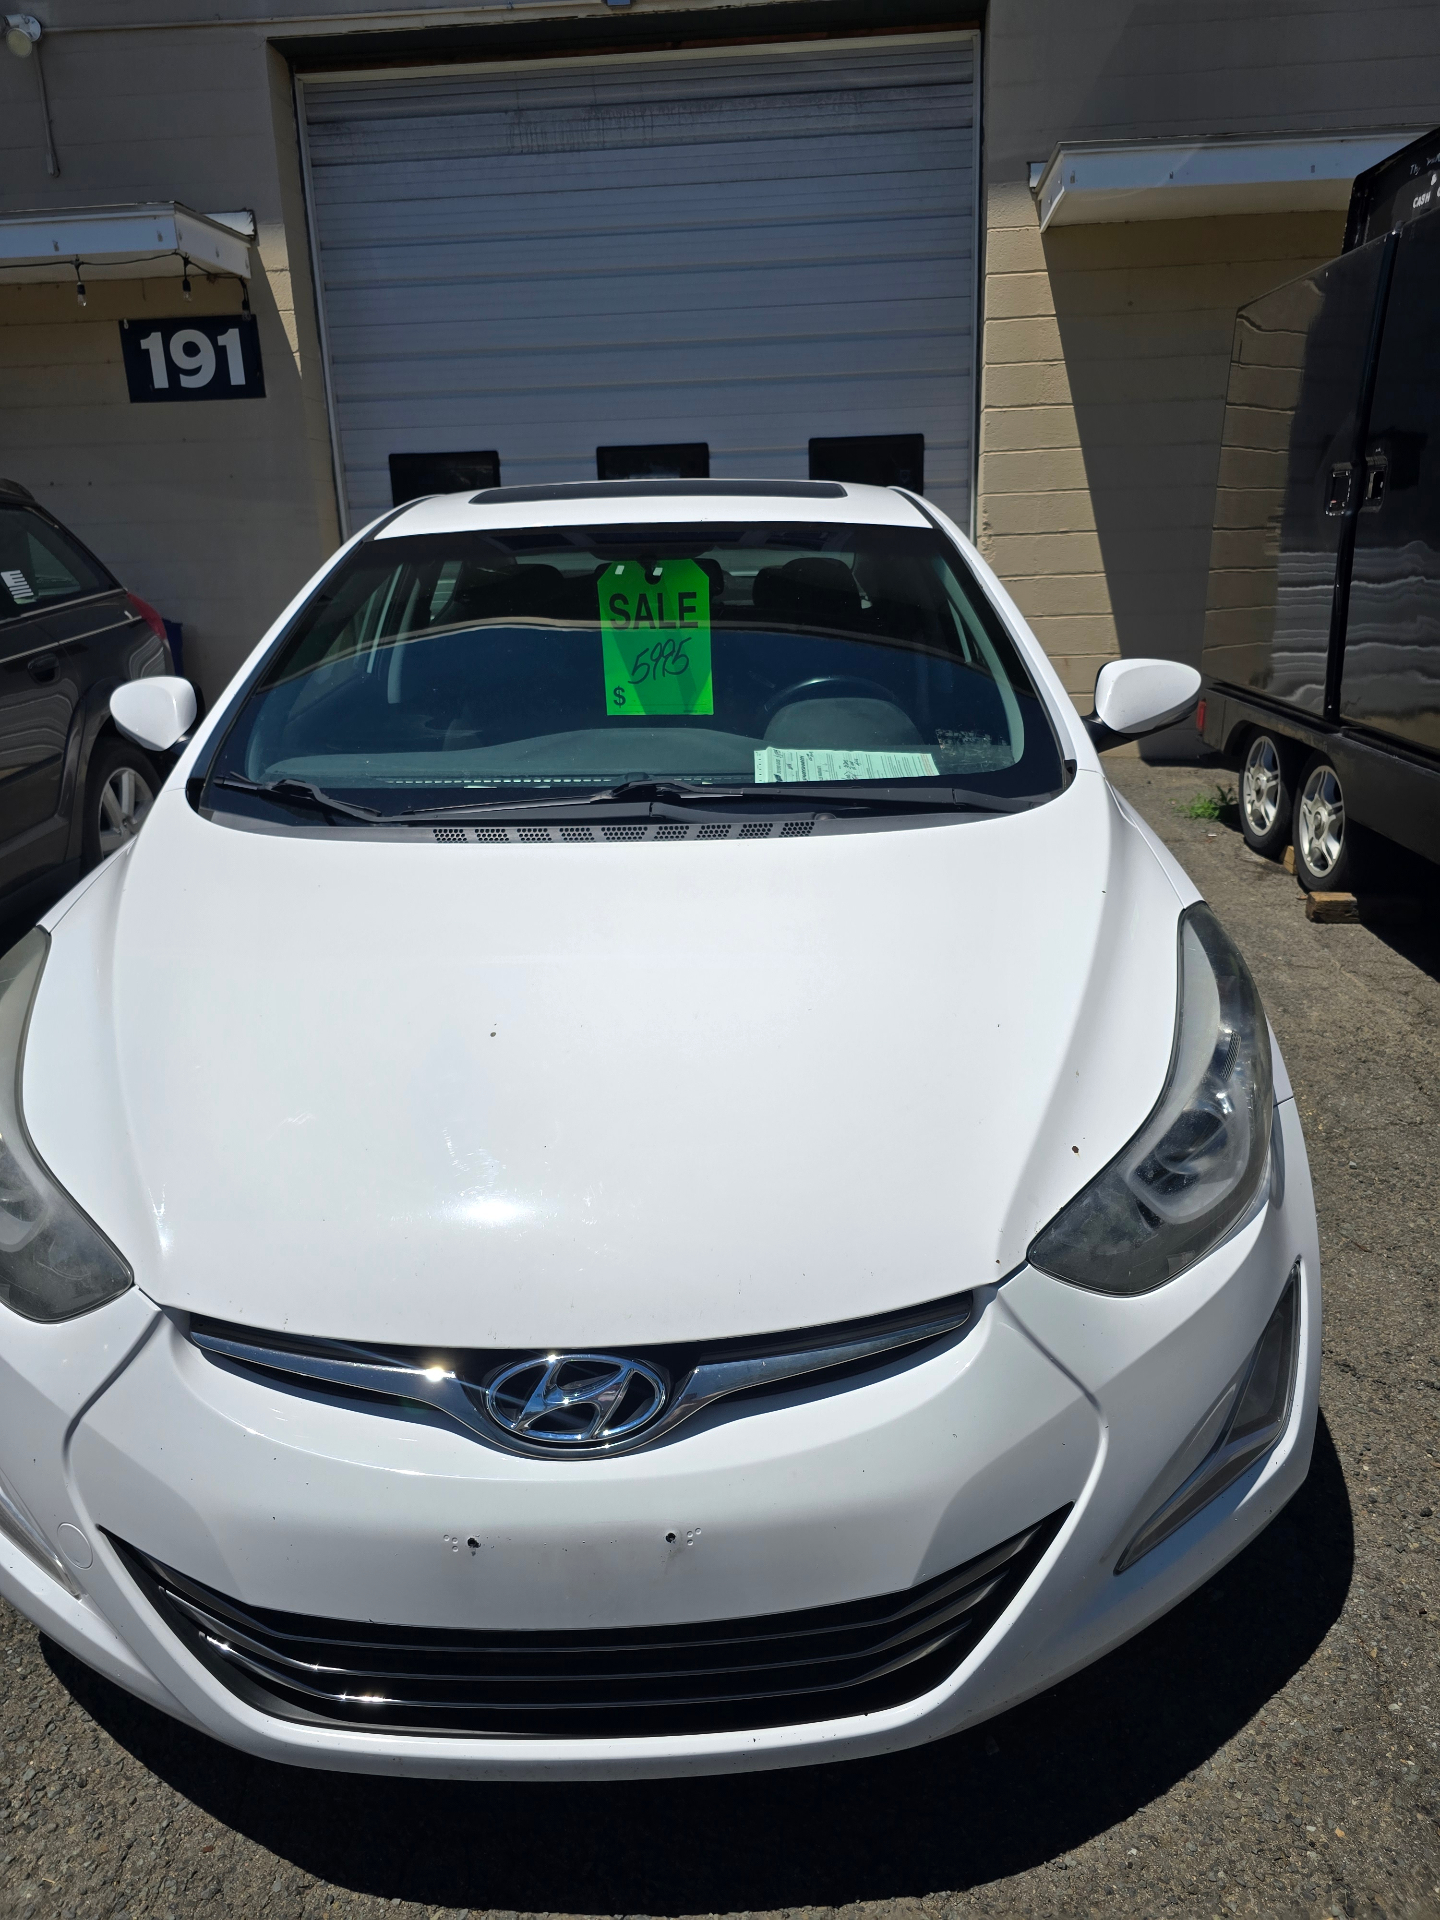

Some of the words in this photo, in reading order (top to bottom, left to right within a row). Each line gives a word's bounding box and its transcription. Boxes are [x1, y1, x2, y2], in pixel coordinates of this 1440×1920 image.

[1413, 190, 1431, 208] CASH
[140, 328, 246, 389] 191
[609, 591, 699, 630] SALE
[628, 637, 692, 684] 5995
[613, 686, 626, 708] $
